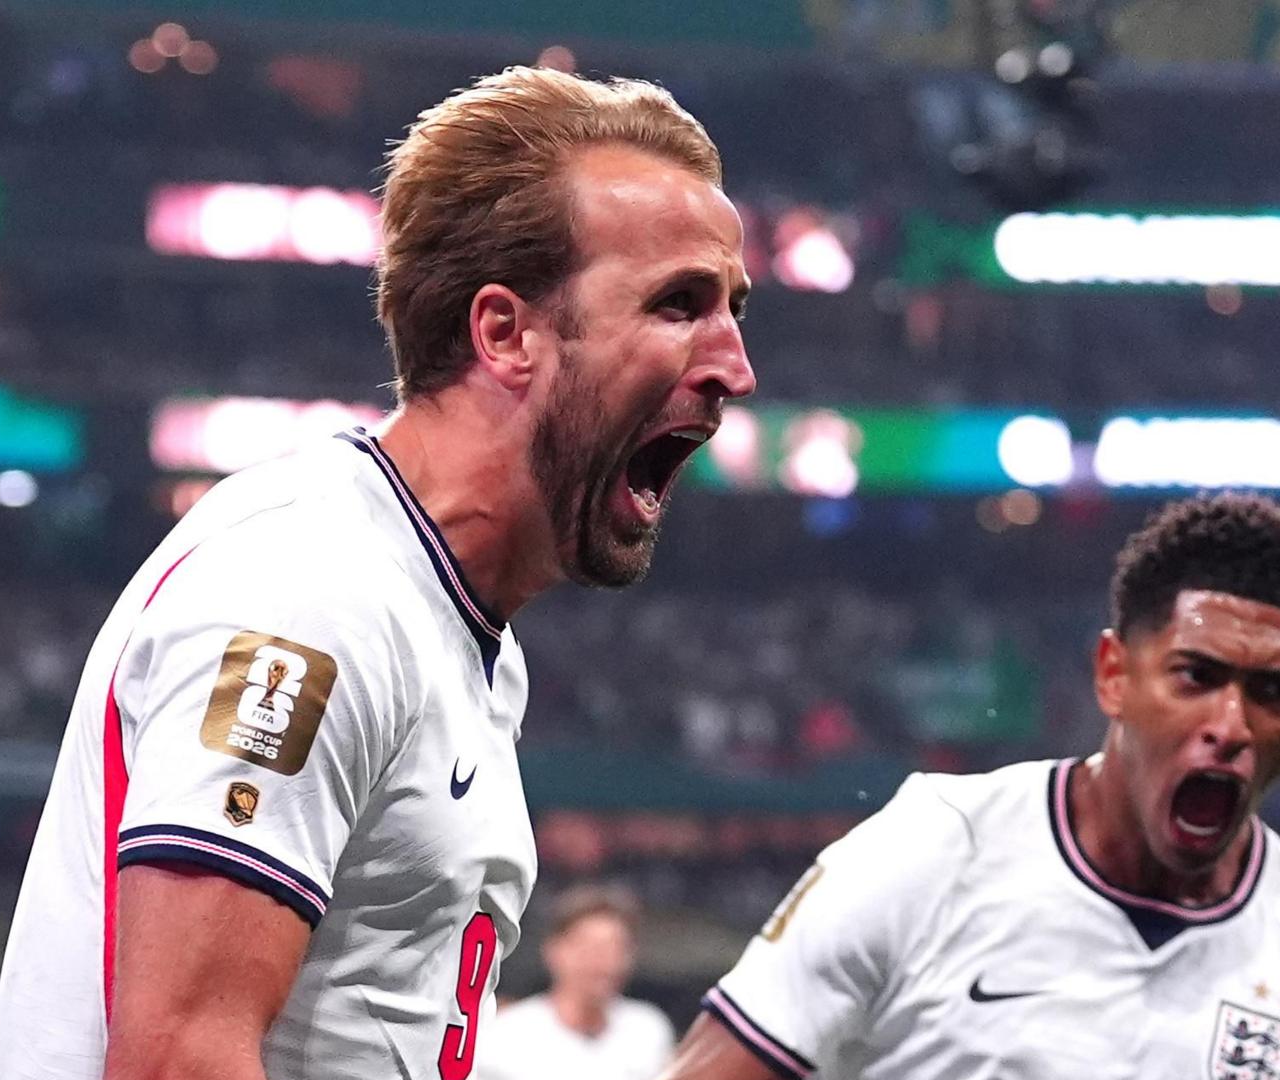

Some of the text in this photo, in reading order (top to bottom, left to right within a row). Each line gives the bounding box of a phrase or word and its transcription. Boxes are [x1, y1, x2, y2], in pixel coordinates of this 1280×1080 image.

[251, 709, 275, 725] FIFA
[225, 733, 279, 760] 2026
[231, 723, 283, 747] WORLD CUP
